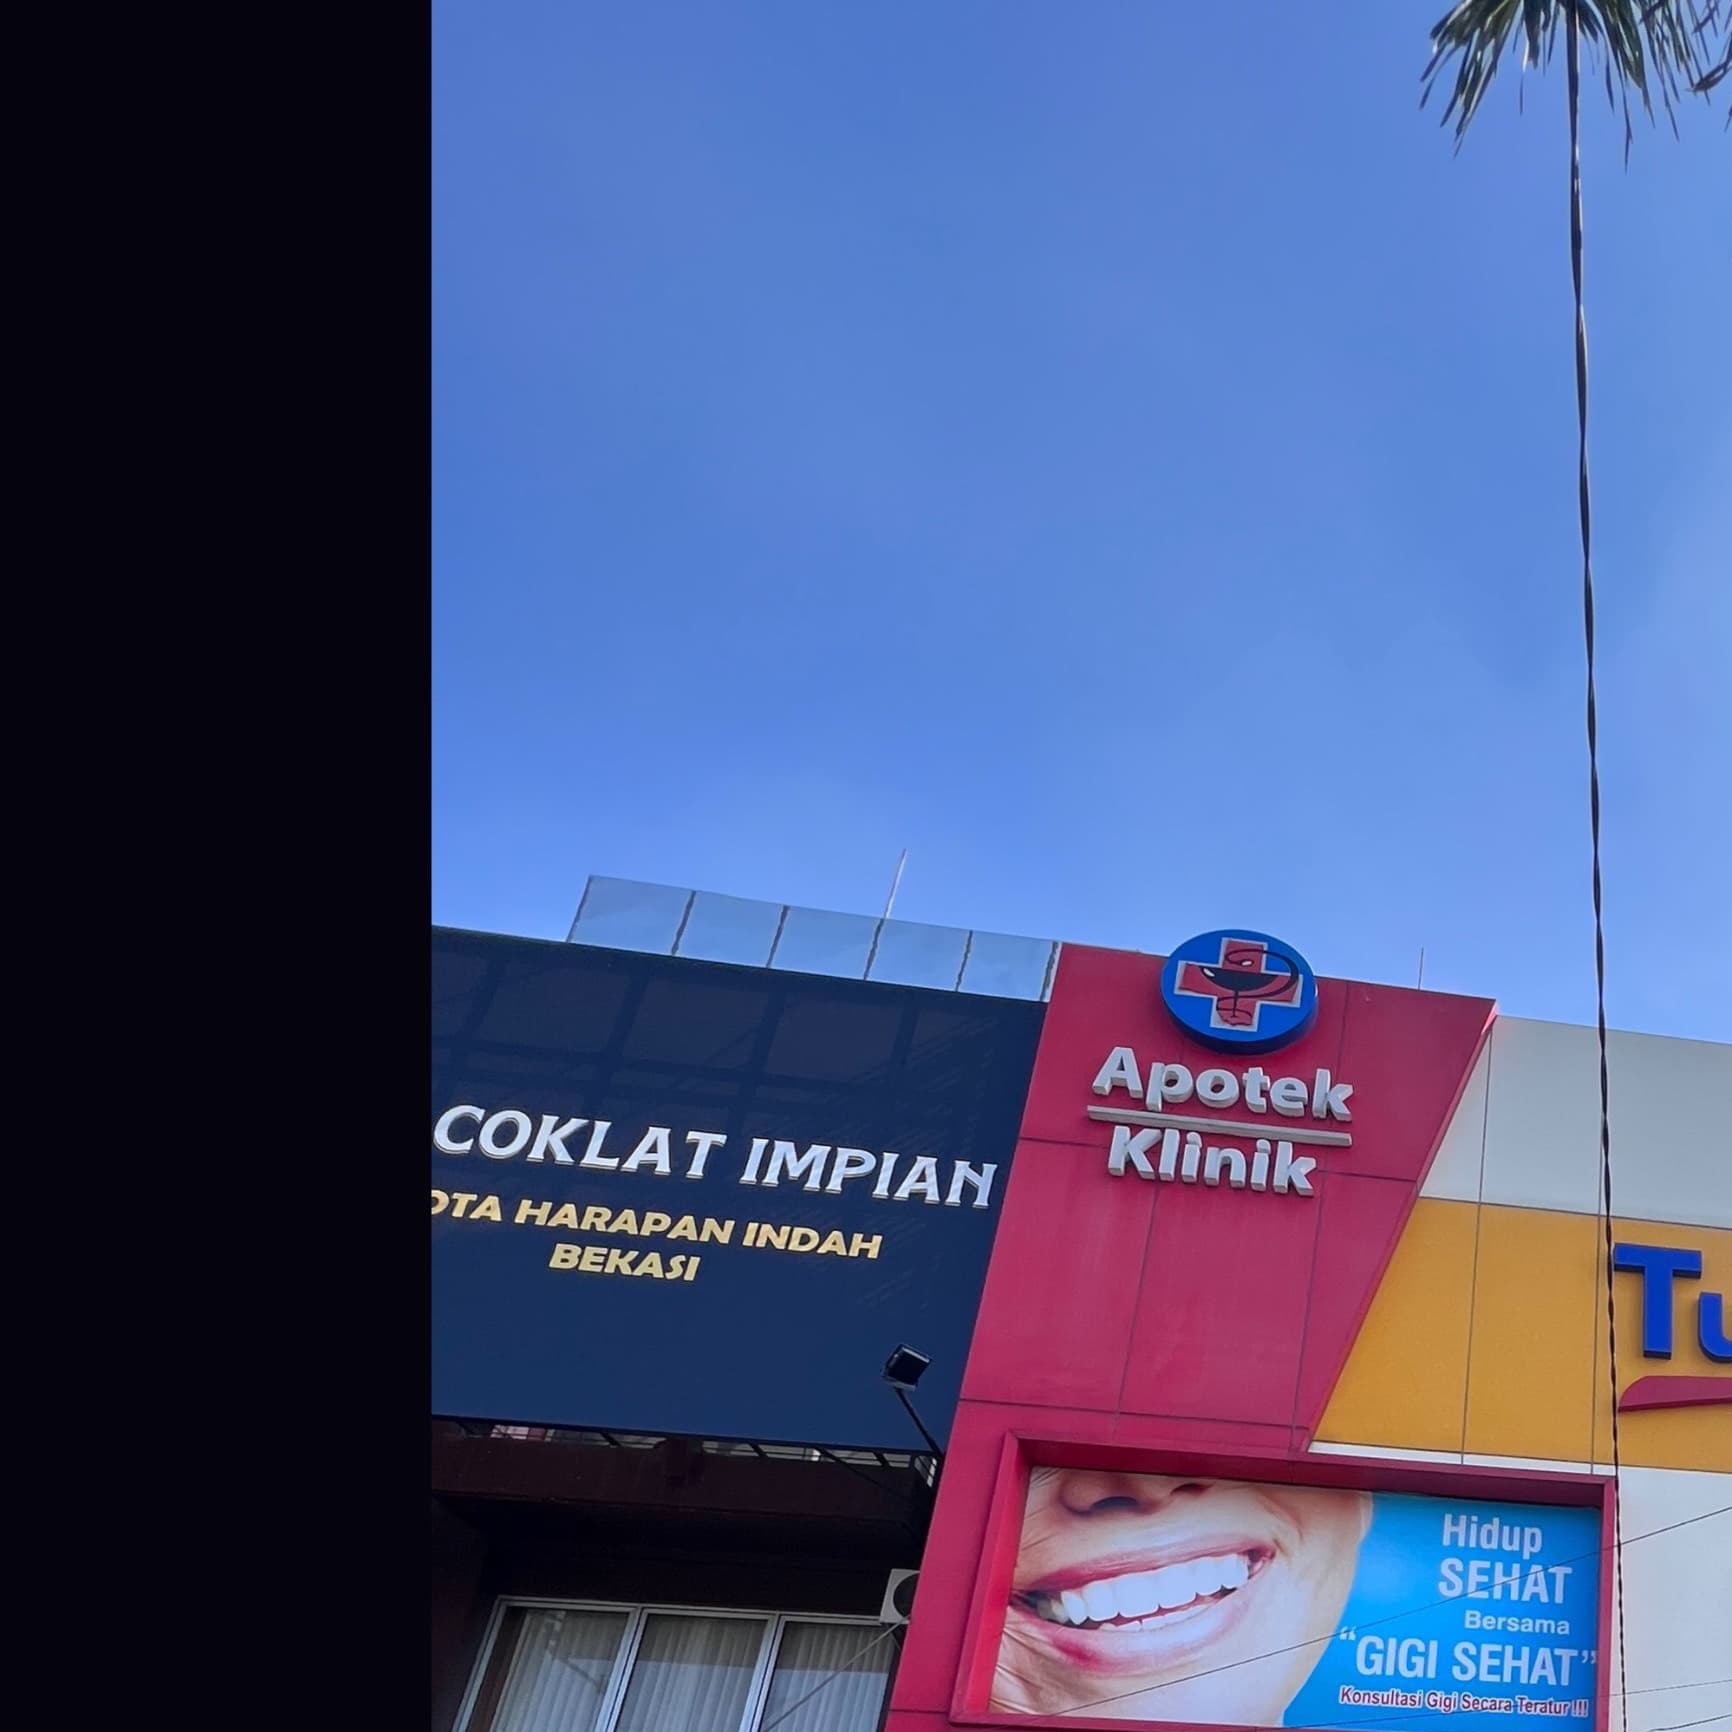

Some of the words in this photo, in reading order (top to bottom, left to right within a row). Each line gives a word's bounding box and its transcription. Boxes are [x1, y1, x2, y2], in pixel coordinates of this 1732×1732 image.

[1092, 1046, 1354, 1121] Apotek
[432, 1104, 727, 1179] COKLAT
[740, 1137, 998, 1209] IMPIAN
[1108, 1125, 1317, 1196] Klinik
[514, 1200, 736, 1245] HARAPAN
[741, 1222, 884, 1260] INDAH
[548, 1244, 701, 1281] BEKASI
[1442, 1513, 1543, 1560] Hidup
[1438, 1558, 1572, 1604] SEHAT
[1464, 1610, 1571, 1635] Bersama
[1339, 1686, 1424, 1708] Konsultasi
[1427, 1692, 1458, 1713] Gigi
[1461, 1693, 1512, 1712] Secara
[1517, 1696, 1569, 1715] Teratur
